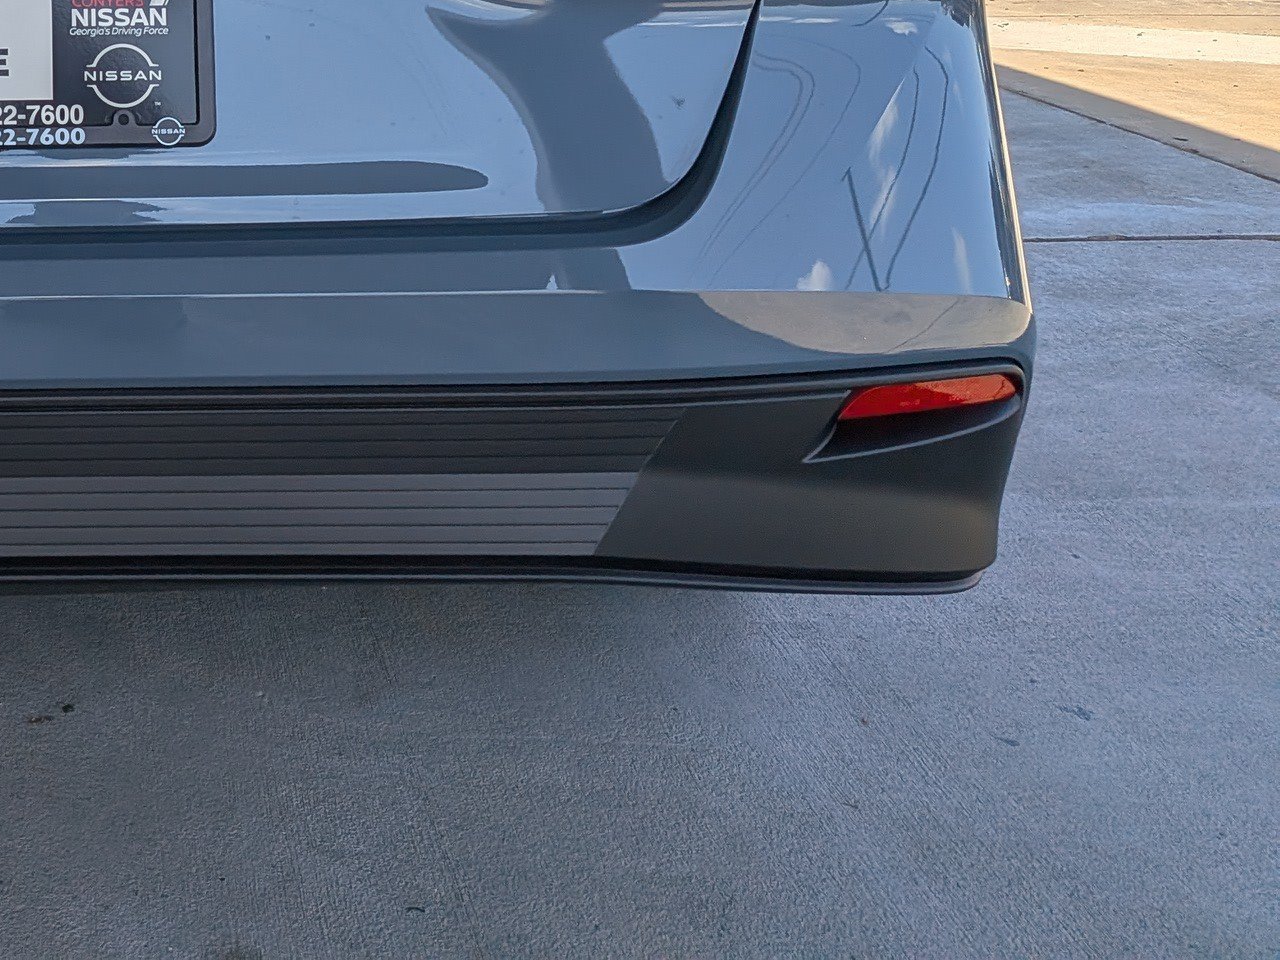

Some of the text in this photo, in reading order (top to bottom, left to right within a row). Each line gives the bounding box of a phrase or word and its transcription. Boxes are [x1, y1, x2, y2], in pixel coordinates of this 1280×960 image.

[71, 8, 167, 27] NISSAN
[111, 26, 142, 37] Driving
[143, 26, 169, 35] Force
[84, 70, 162, 82] NISSAN
[151, 127, 186, 136] NISSAN
